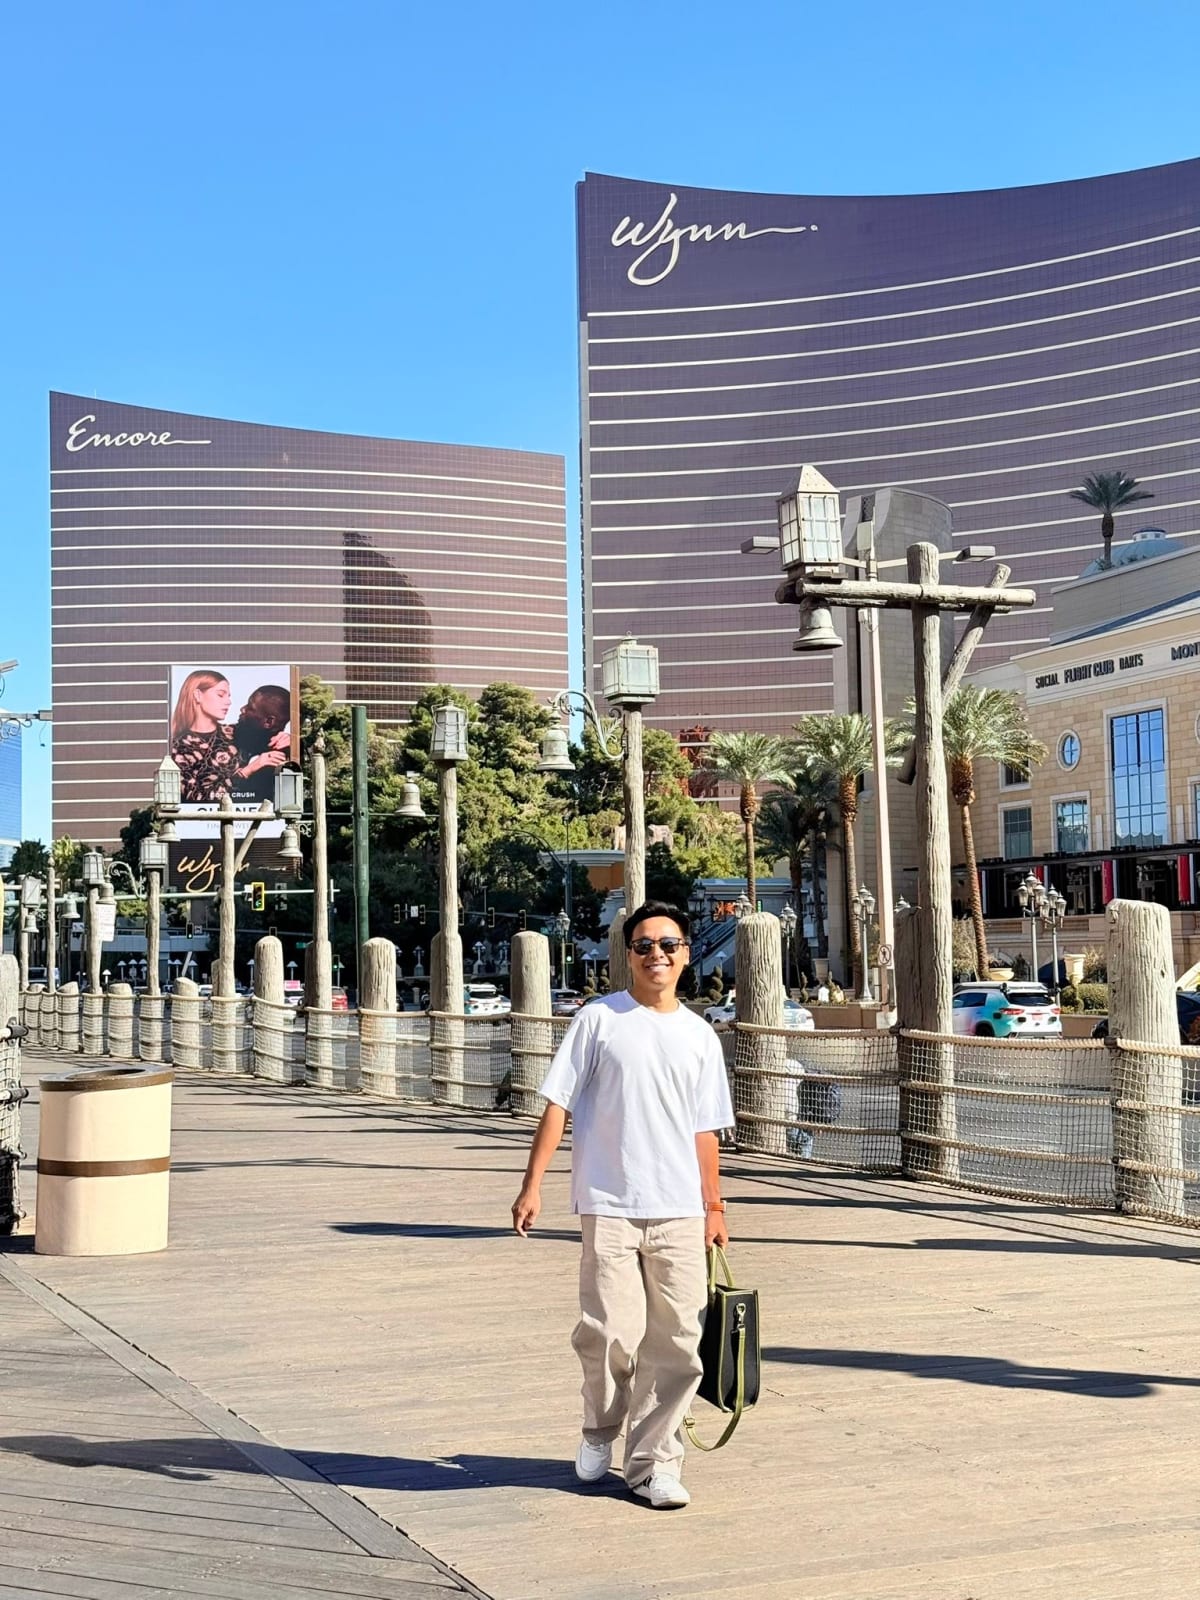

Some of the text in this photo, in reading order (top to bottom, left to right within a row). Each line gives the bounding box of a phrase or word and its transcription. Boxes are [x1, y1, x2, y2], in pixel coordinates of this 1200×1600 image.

[65, 414, 212, 452] Encore
[1035, 653, 1144, 689] SOCIAL FLIGHT CLUB DARTS
